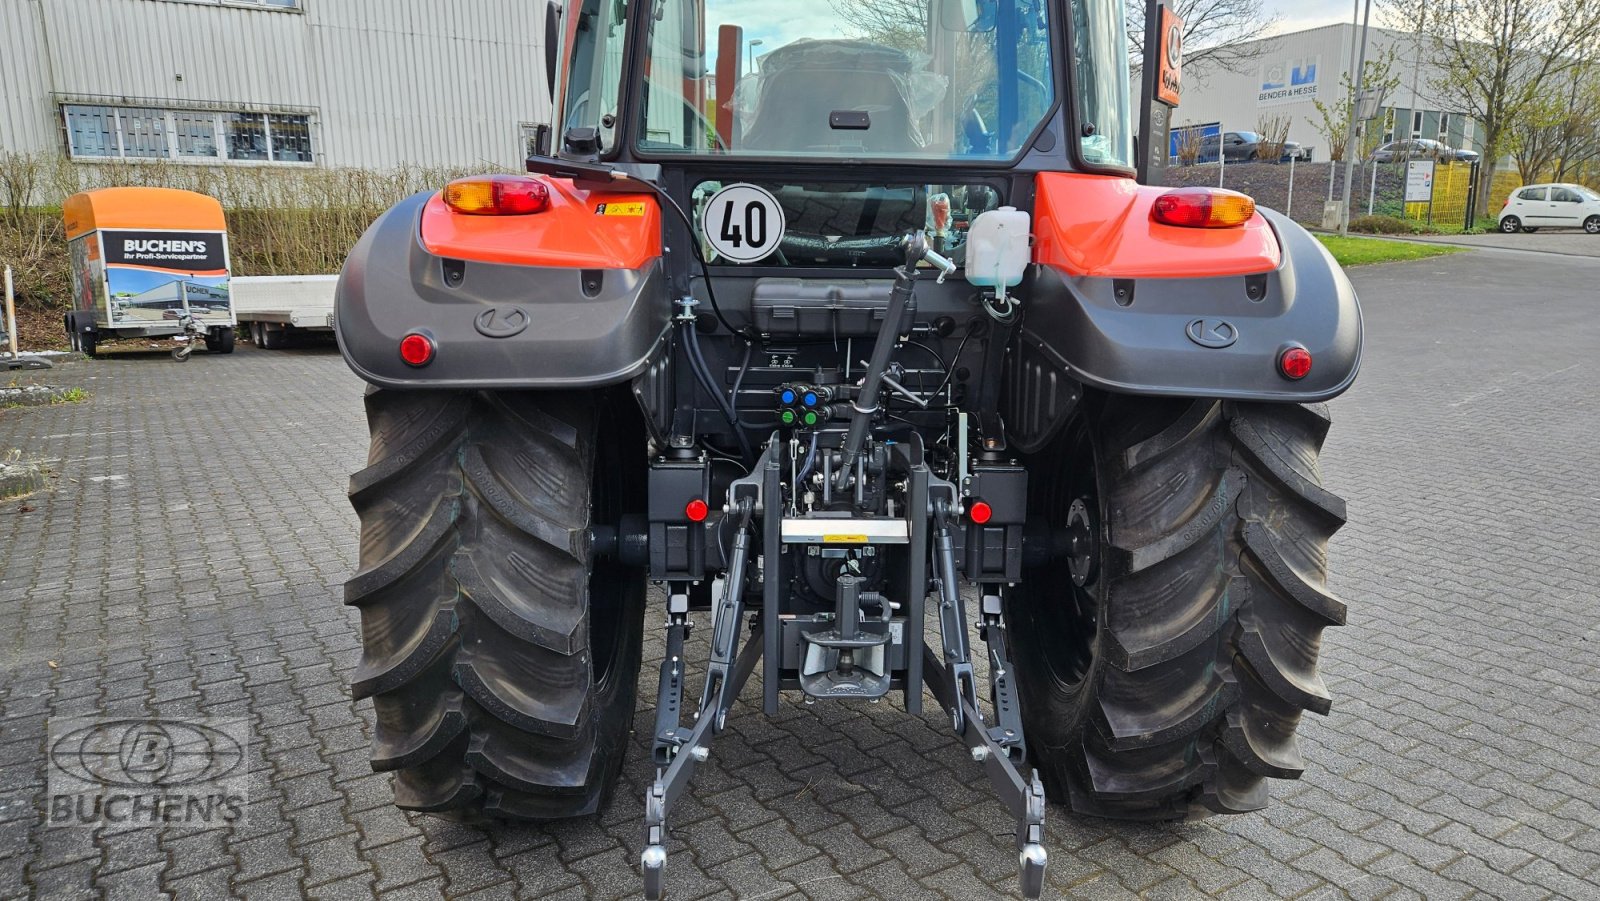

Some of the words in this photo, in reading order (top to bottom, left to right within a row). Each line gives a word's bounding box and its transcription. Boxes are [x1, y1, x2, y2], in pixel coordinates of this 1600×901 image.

[1259, 89, 1287, 101] BENDER
[1288, 89, 1293, 97] &
[1294, 85, 1318, 96] HESSE
[720, 200, 767, 249] 40
[124, 239, 207, 252] BUCHEN'S
[136, 253, 208, 261] Profi-Servicepartner
